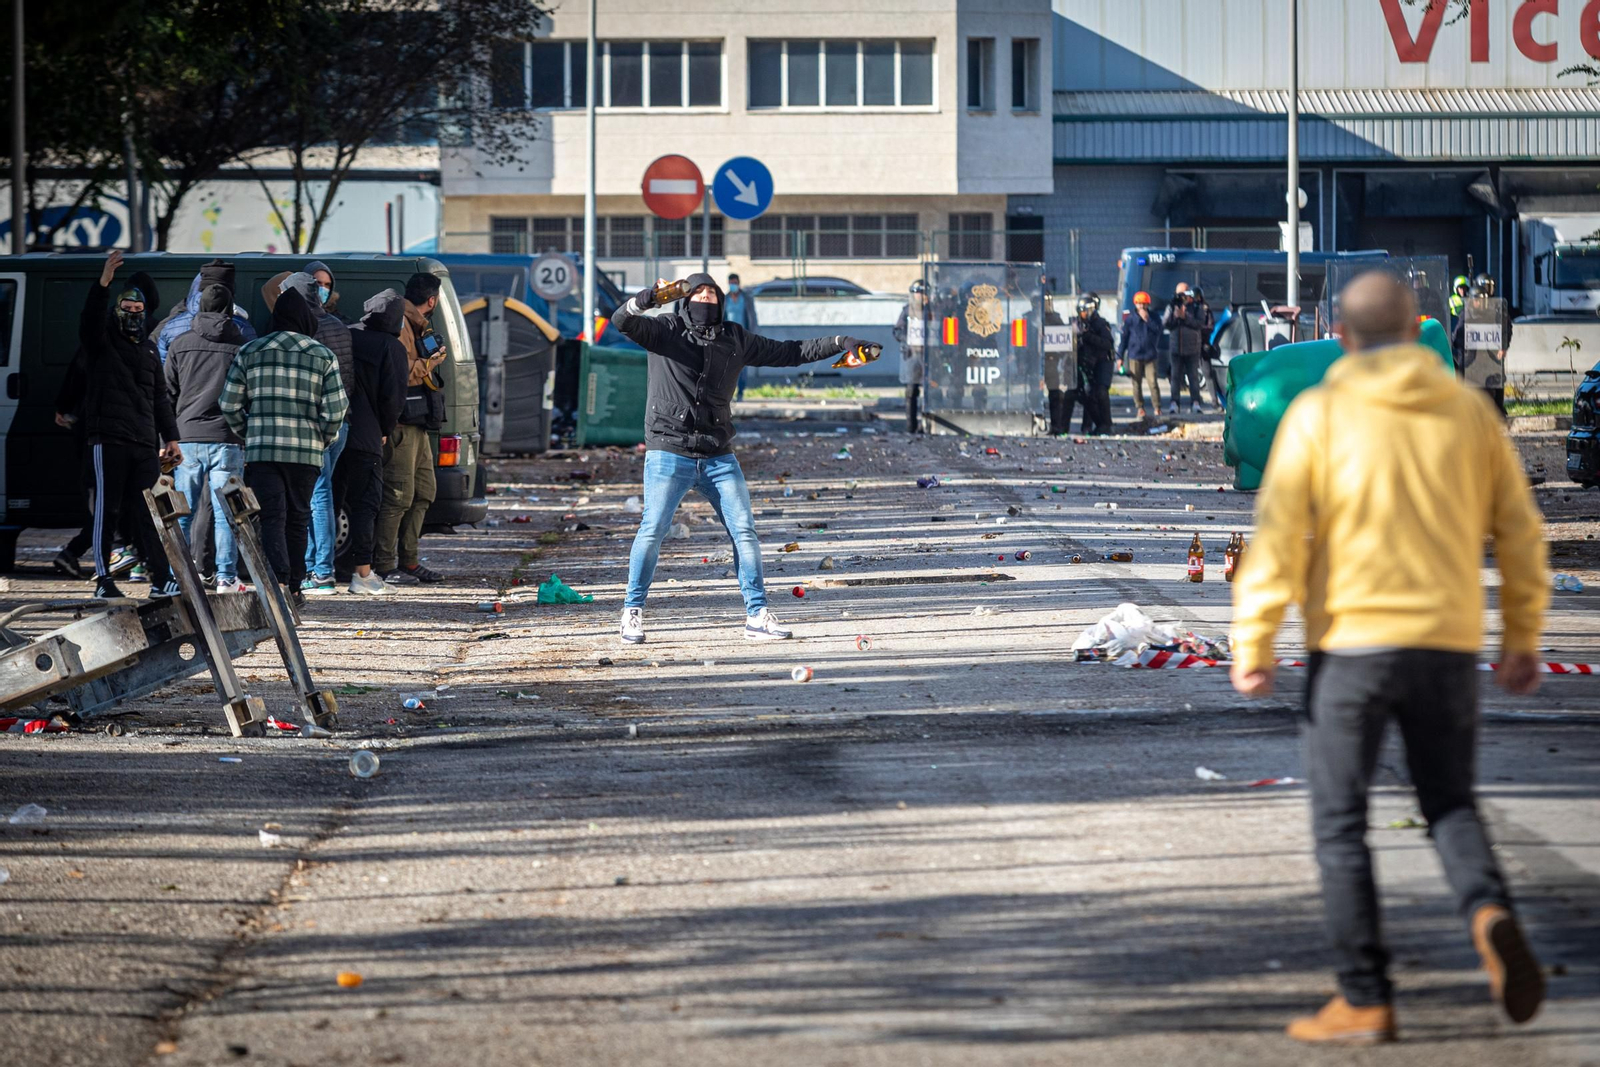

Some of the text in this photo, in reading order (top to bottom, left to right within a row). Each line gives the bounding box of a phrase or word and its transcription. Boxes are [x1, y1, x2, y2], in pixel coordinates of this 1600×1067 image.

[541, 266, 567, 285] 20
[1466, 331, 1501, 343] POLICIA
[966, 347, 1000, 359] POLICIA
[966, 366, 1001, 385] UIP
